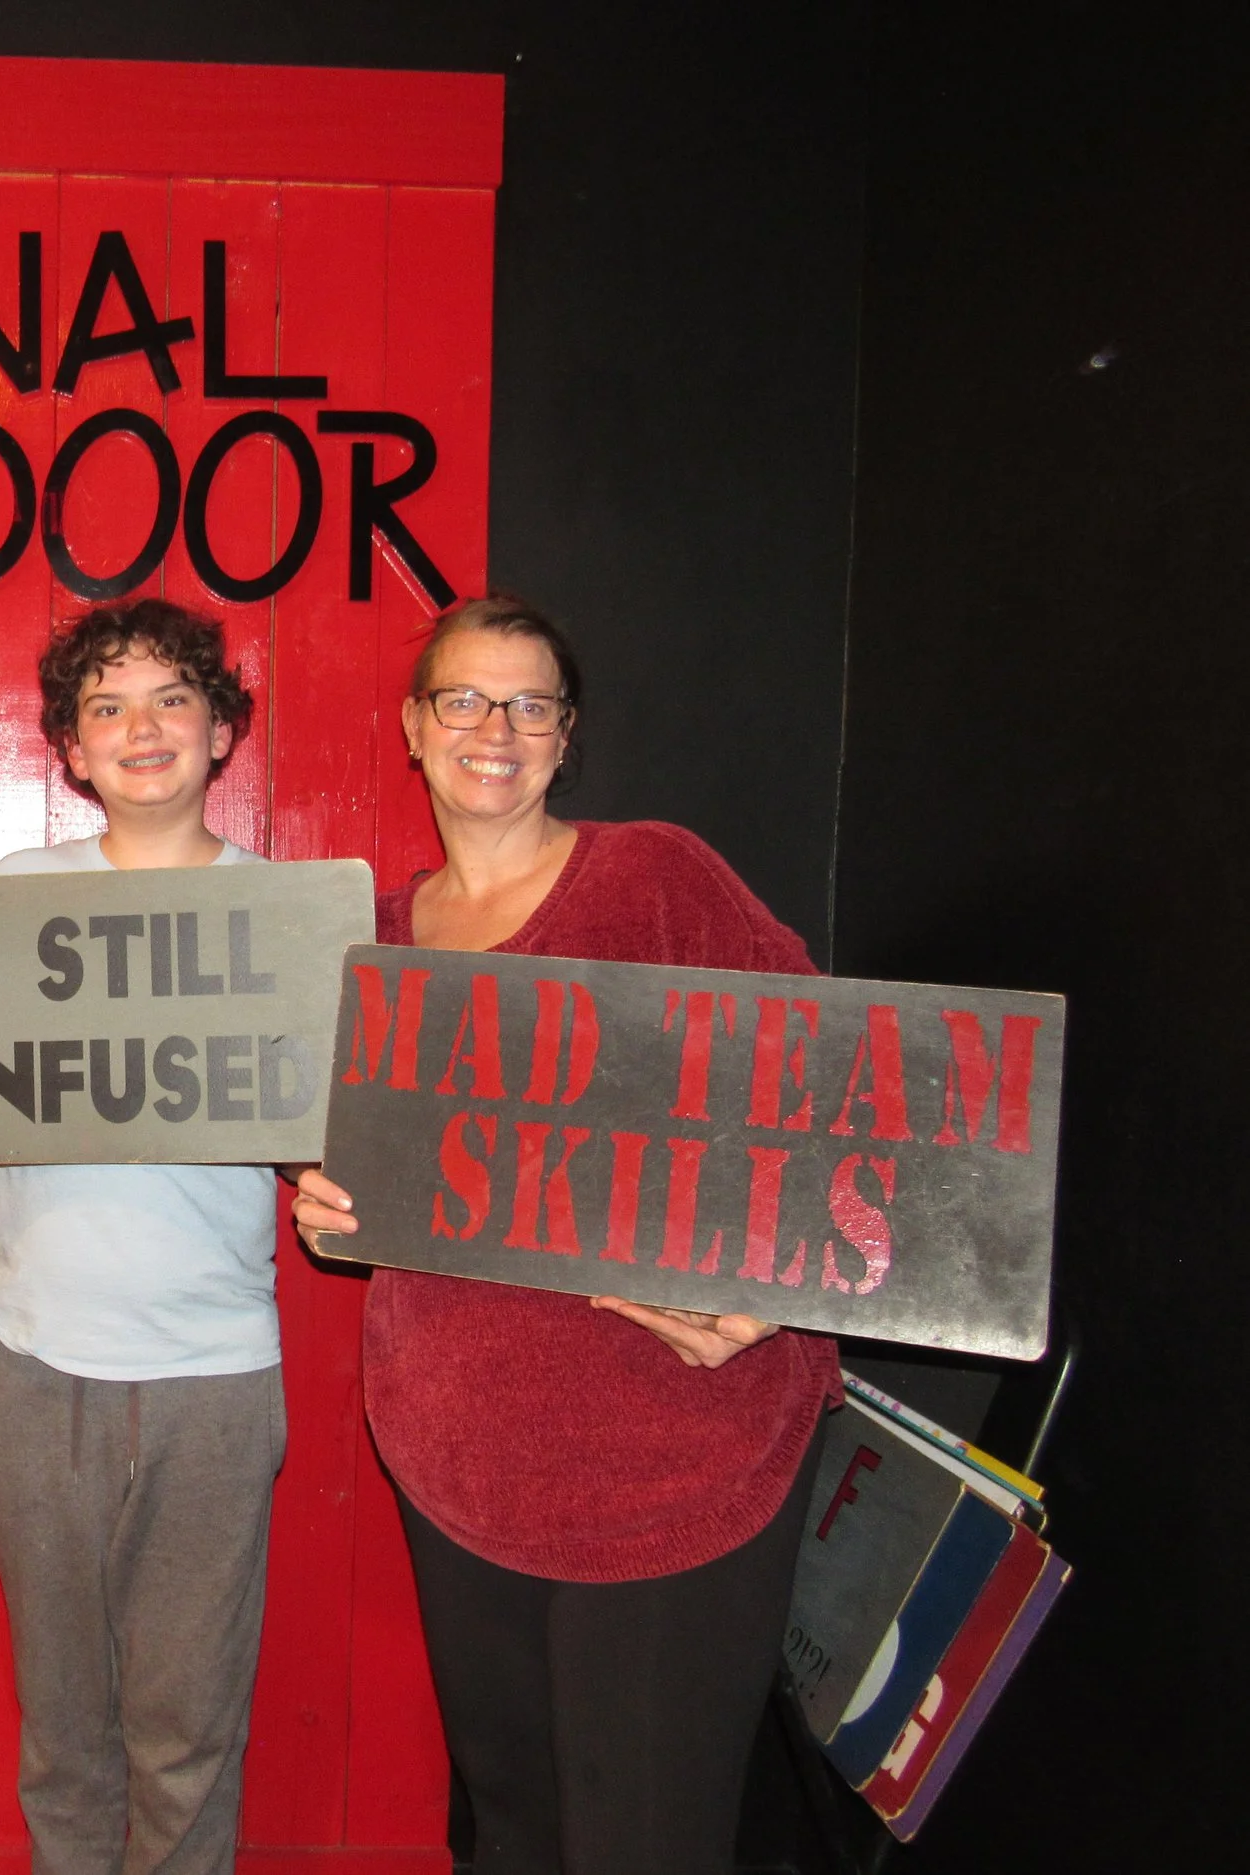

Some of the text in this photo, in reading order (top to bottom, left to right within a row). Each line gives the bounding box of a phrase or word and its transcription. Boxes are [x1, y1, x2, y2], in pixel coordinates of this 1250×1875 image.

[37, 910, 276, 1002] STILL
[342, 964, 1041, 1155] MAD TEAM
[431, 1112, 896, 1295] SKILLS
